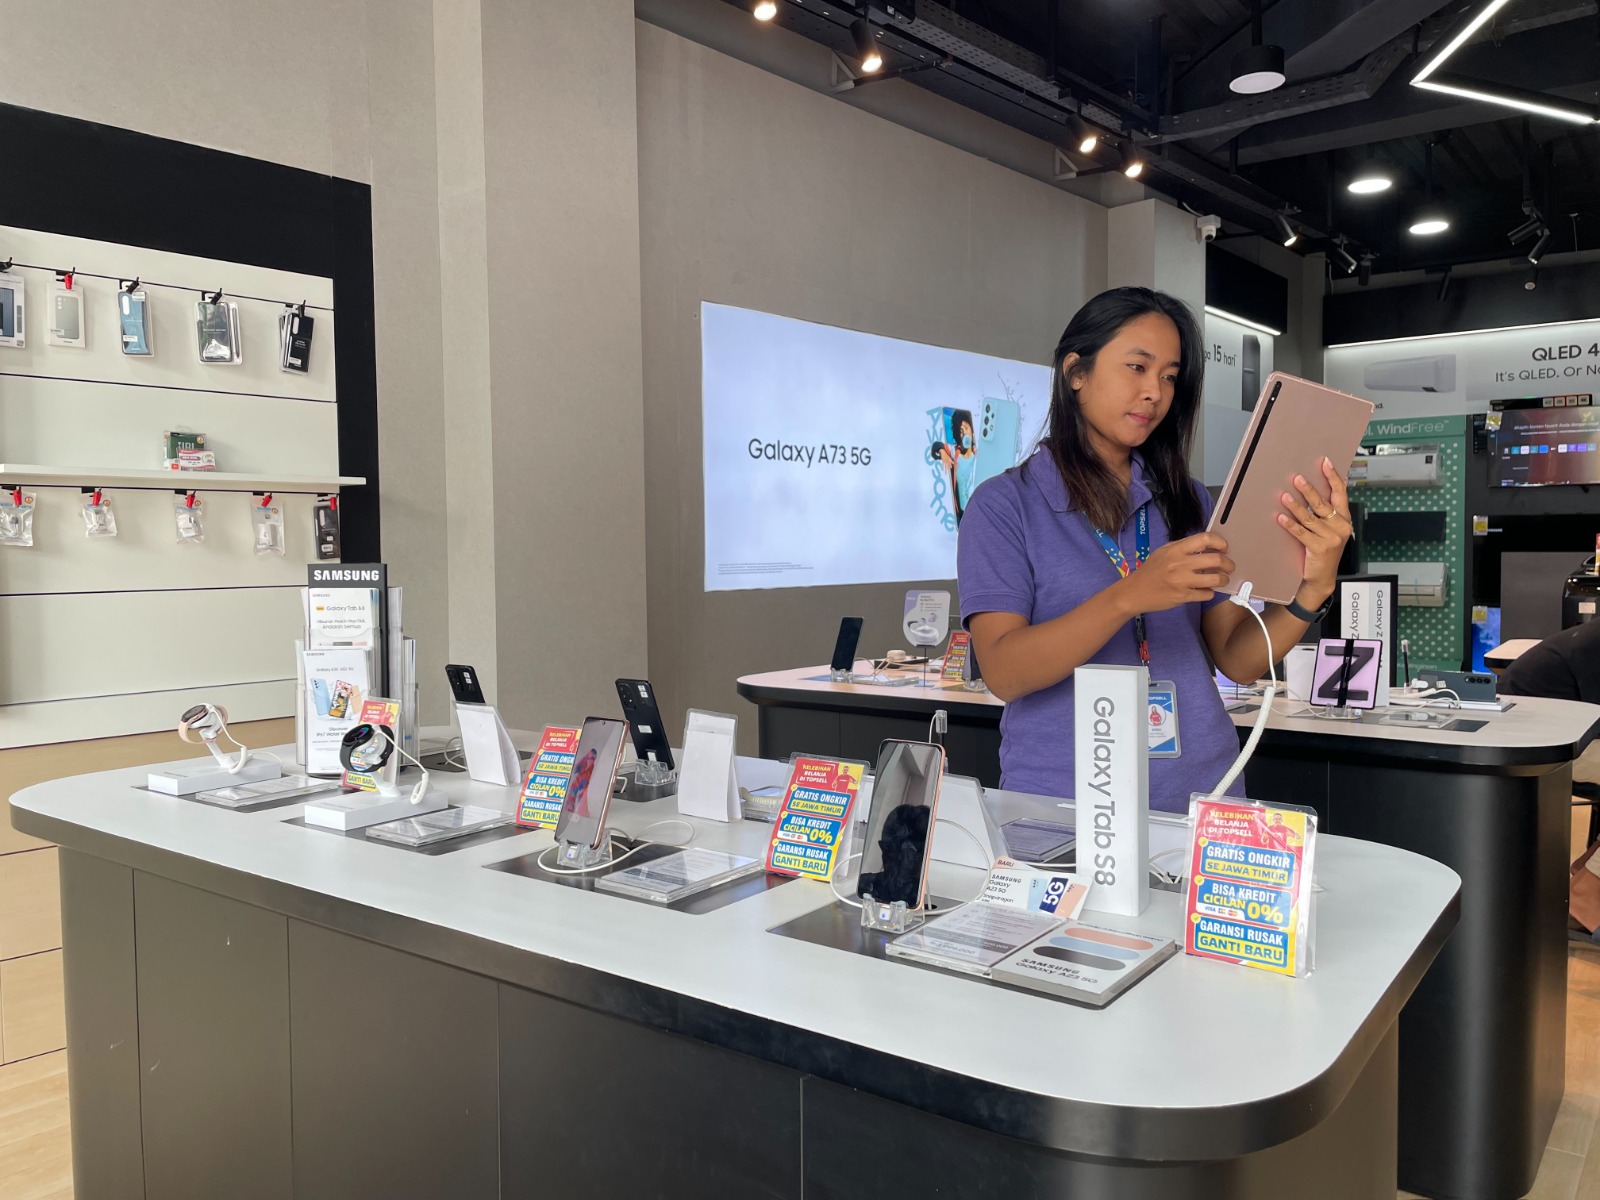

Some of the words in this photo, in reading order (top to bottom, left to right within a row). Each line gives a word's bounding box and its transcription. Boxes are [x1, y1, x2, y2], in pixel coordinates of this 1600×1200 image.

[1213, 344, 1222, 362] 15
[1532, 345, 1582, 361] QLED
[1495, 371, 1515, 382] It's
[1519, 368, 1559, 381] QLED.
[1564, 366, 1582, 377] Or
[1586, 364, 1600, 375] No
[748, 438, 816, 469] Galaxy
[818, 444, 847, 465] A73
[850, 446, 872, 466] 5G
[314, 569, 380, 581] SAMSUNG
[1350, 592, 1360, 631] Galaxy
[1375, 590, 1383, 631] Galaxy
[1087, 696, 1116, 797] Galaxy
[540, 753, 559, 762] GRATIS
[559, 755, 575, 764] ONGK
[558, 764, 571, 772] TIMU
[548, 777, 566, 785] KREDIT
[524, 800, 545, 810] GARANSI
[794, 790, 819, 801] GRATIS
[821, 793, 848, 805] ONGKIR
[523, 811, 541, 819] GANTI
[542, 812, 559, 821] BARU
[801, 802, 819, 811] JAWA
[820, 805, 842, 814] TIMUR
[1210, 809, 1255, 821] KELEBIHAN
[790, 816, 806, 825] BISA
[807, 818, 832, 829] KREDIT
[1093, 800, 1116, 850] Tab
[1213, 818, 1250, 828] BELANJA
[783, 824, 810, 834] CICILAN
[809, 828, 833, 844] 0%
[1208, 826, 1219, 835] DI
[1219, 827, 1254, 837] TOPSELL
[777, 843, 805, 856] GARANSI
[806, 848, 829, 860] RUSAK
[1206, 845, 1245, 862] GRATIS
[1248, 851, 1291, 869] ONGKIR
[775, 855, 801, 867] GANTI
[802, 859, 827, 872] BARU
[997, 859, 1015, 868] BARU
[1093, 853, 1116, 886] S8
[1207, 862, 1220, 871] SE
[1221, 863, 1250, 876] JAWA
[1252, 868, 1287, 882] TIMUR
[988, 880, 1011, 888] Galaxy
[991, 873, 1022, 884] SAMSUNG
[1043, 881, 1065, 906] 5G
[1212, 883, 1236, 897] BISA
[1238, 887, 1277, 904] KREDIT
[1203, 893, 1247, 910] CICILAN
[1247, 902, 1284, 924] 0%
[1204, 905, 1217, 913] VISA
[1199, 919, 1245, 938] GARANSI
[1247, 928, 1283, 946] RUSAK
[1199, 935, 1241, 953] GANTI
[1244, 943, 1283, 961] BARU
[1015, 961, 1057, 975] Galaxy
[1057, 971, 1081, 980] A23
[1081, 976, 1098, 984] 5G
[1020, 957, 1080, 974] SAMSUNG
